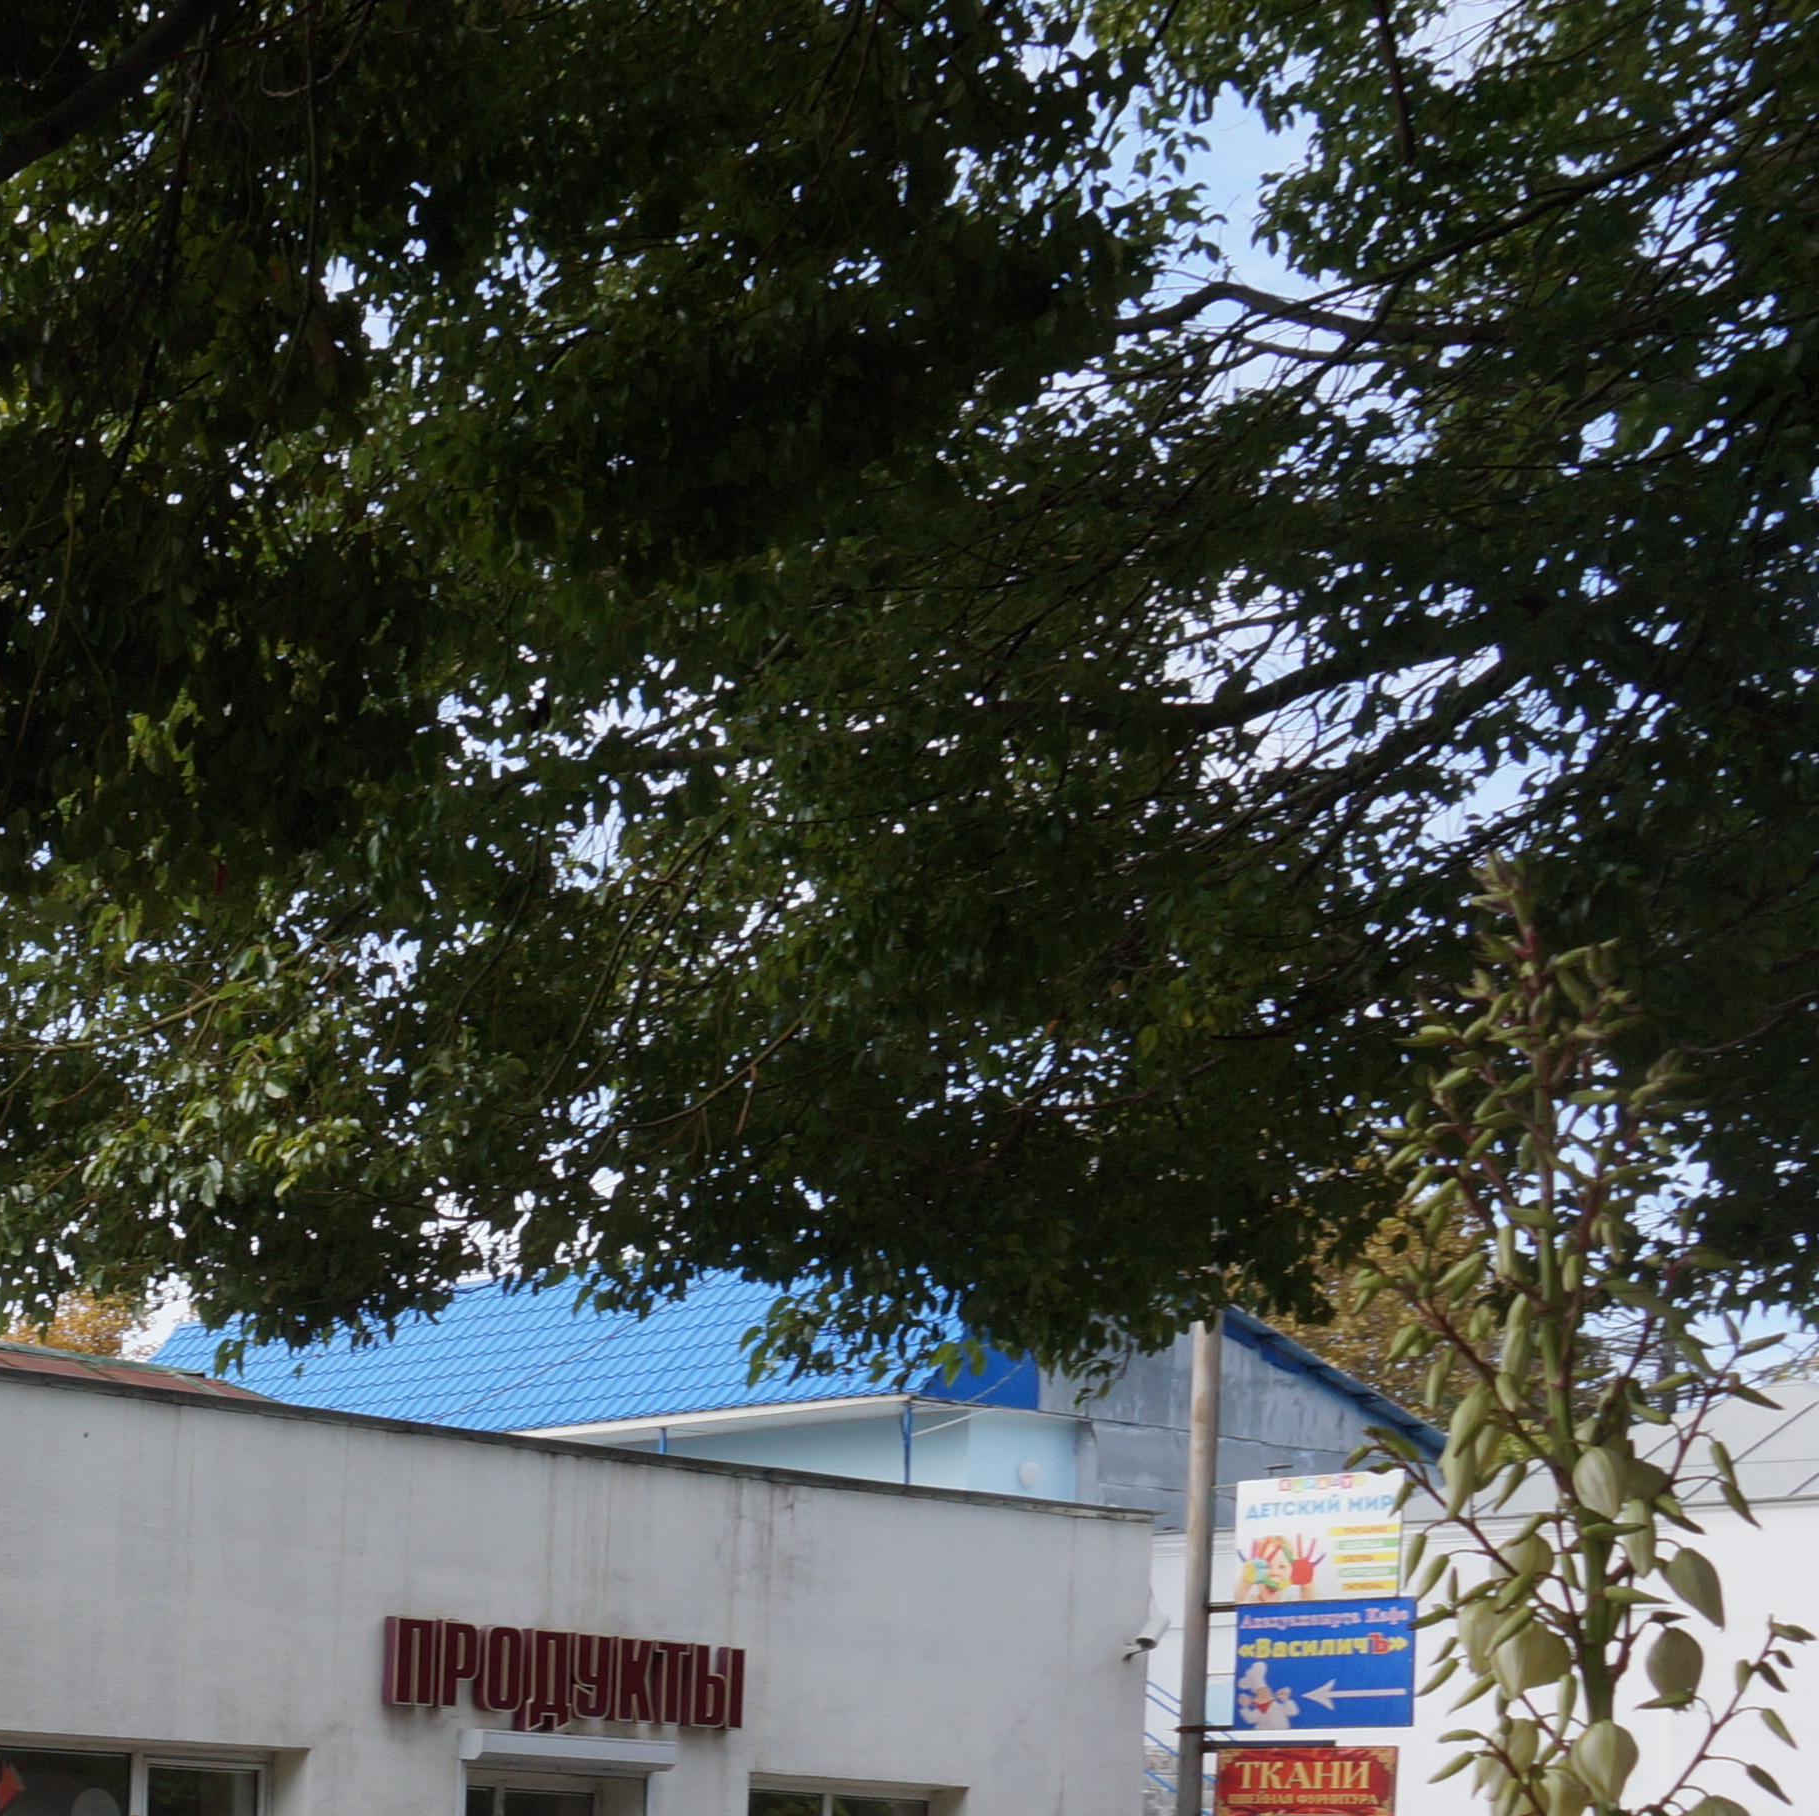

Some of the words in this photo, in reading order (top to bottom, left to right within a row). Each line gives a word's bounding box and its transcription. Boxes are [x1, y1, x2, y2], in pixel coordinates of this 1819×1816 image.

[1245, 1494, 1341, 1520] ДЕТСКИЙ
[1347, 1494, 1394, 1513] МИР
[383, 1615, 747, 1732] ПРОДУКТЫ
[1235, 1761, 1372, 1789] ТКАНИ
